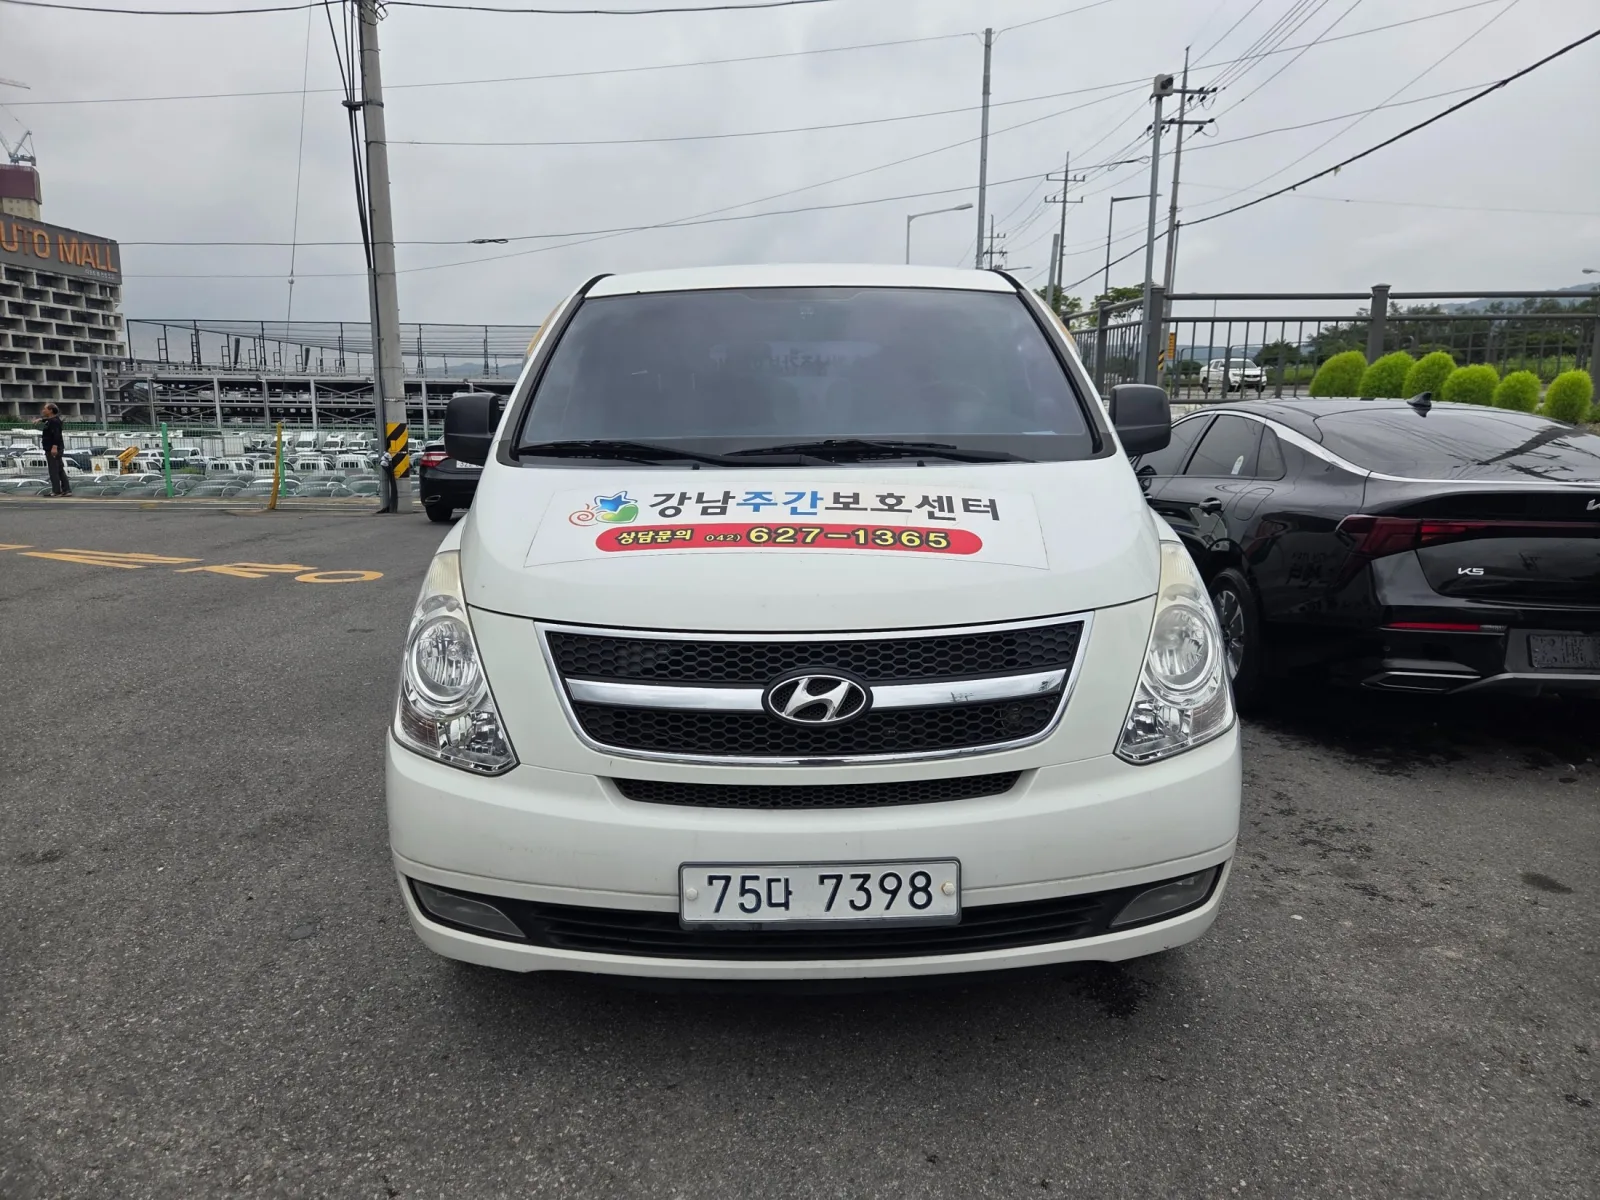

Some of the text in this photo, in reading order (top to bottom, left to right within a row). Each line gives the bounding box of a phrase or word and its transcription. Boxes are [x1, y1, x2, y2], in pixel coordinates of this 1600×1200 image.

[57, 234, 119, 273] MALL
[648, 490, 1001, 522] 강남주간보호센터
[616, 528, 693, 546] 상담문의
[747, 526, 951, 550] 627-1365
[1457, 566, 1485, 576] K5
[707, 870, 934, 914] 75다 7398
